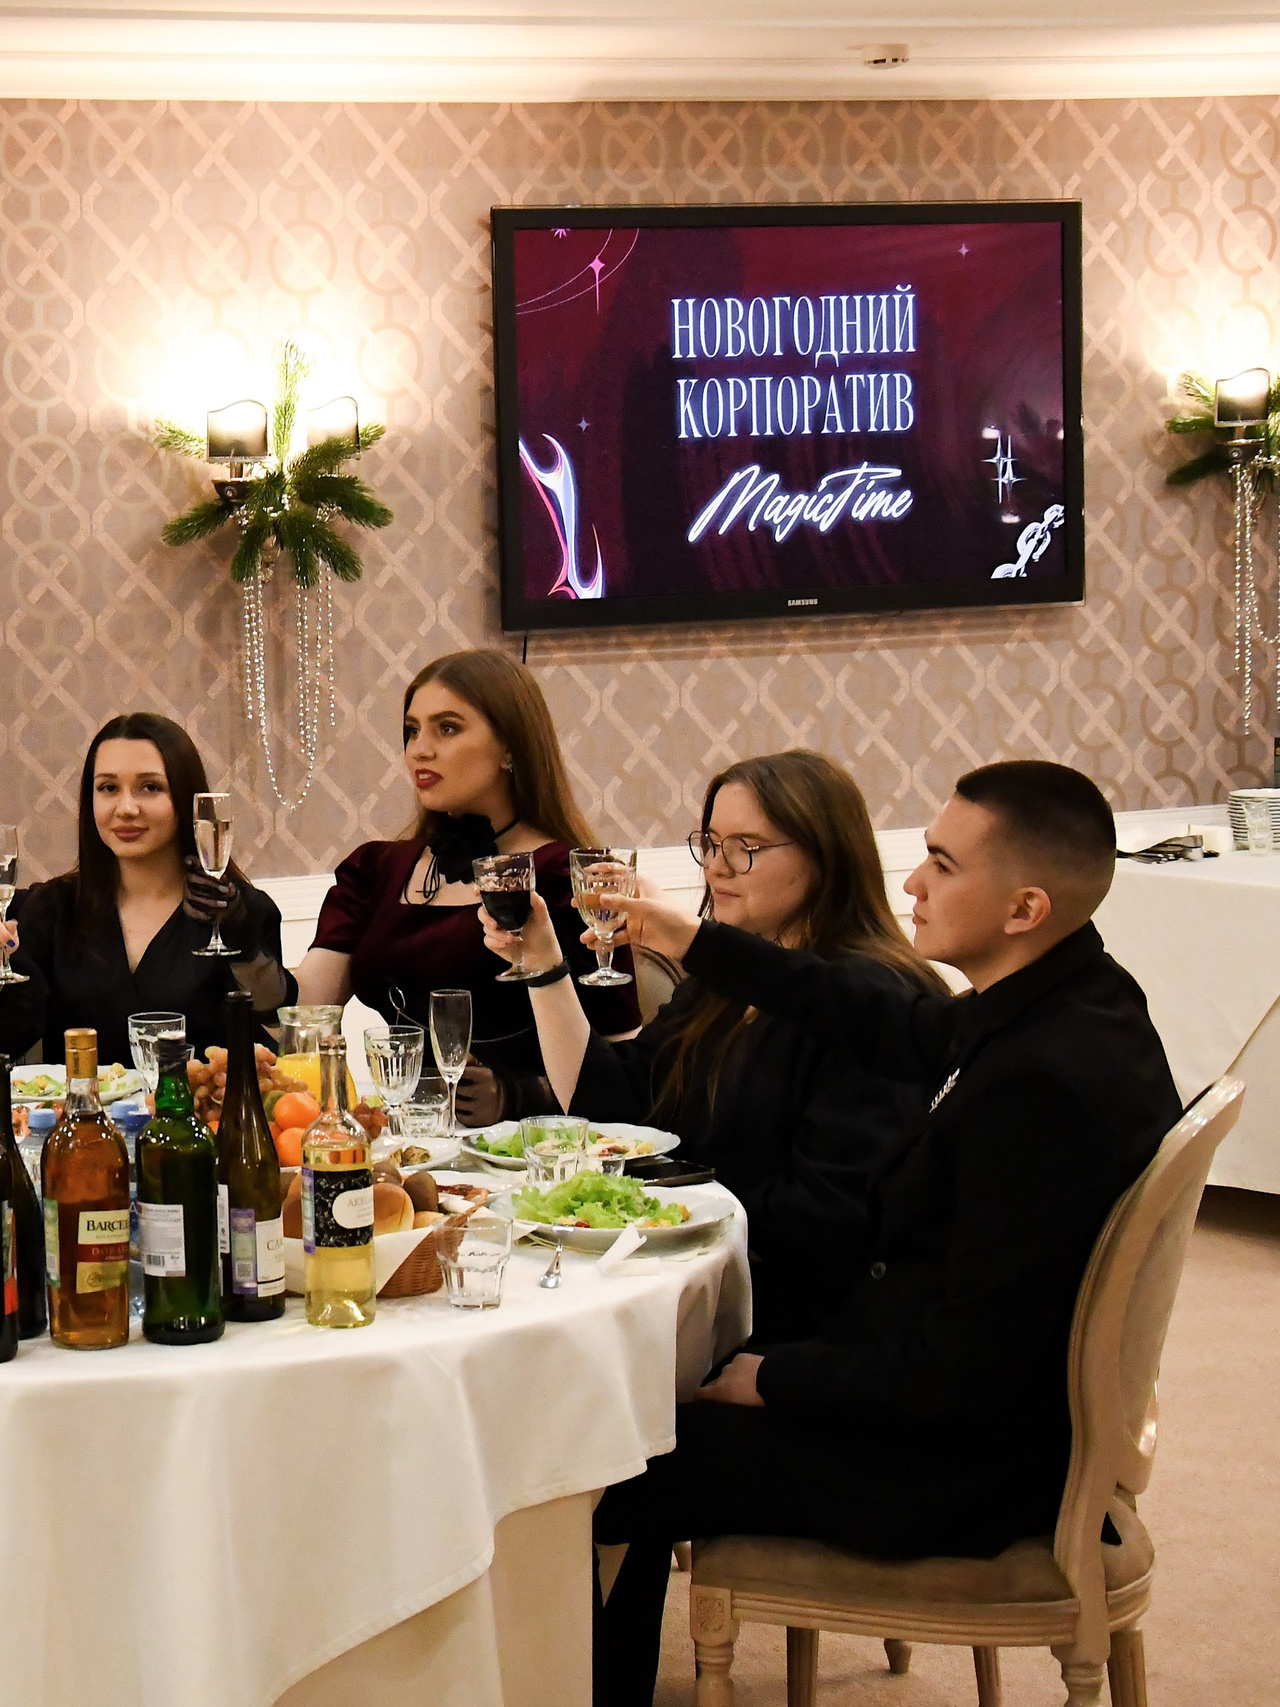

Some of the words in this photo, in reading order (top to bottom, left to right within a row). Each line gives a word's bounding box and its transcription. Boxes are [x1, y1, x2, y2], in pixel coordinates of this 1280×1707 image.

[671, 284, 916, 368] НОВОГОДНИЙ
[677, 373, 915, 439] КОРПОРАТИВ
[787, 598, 818, 607] SAMSUNG
